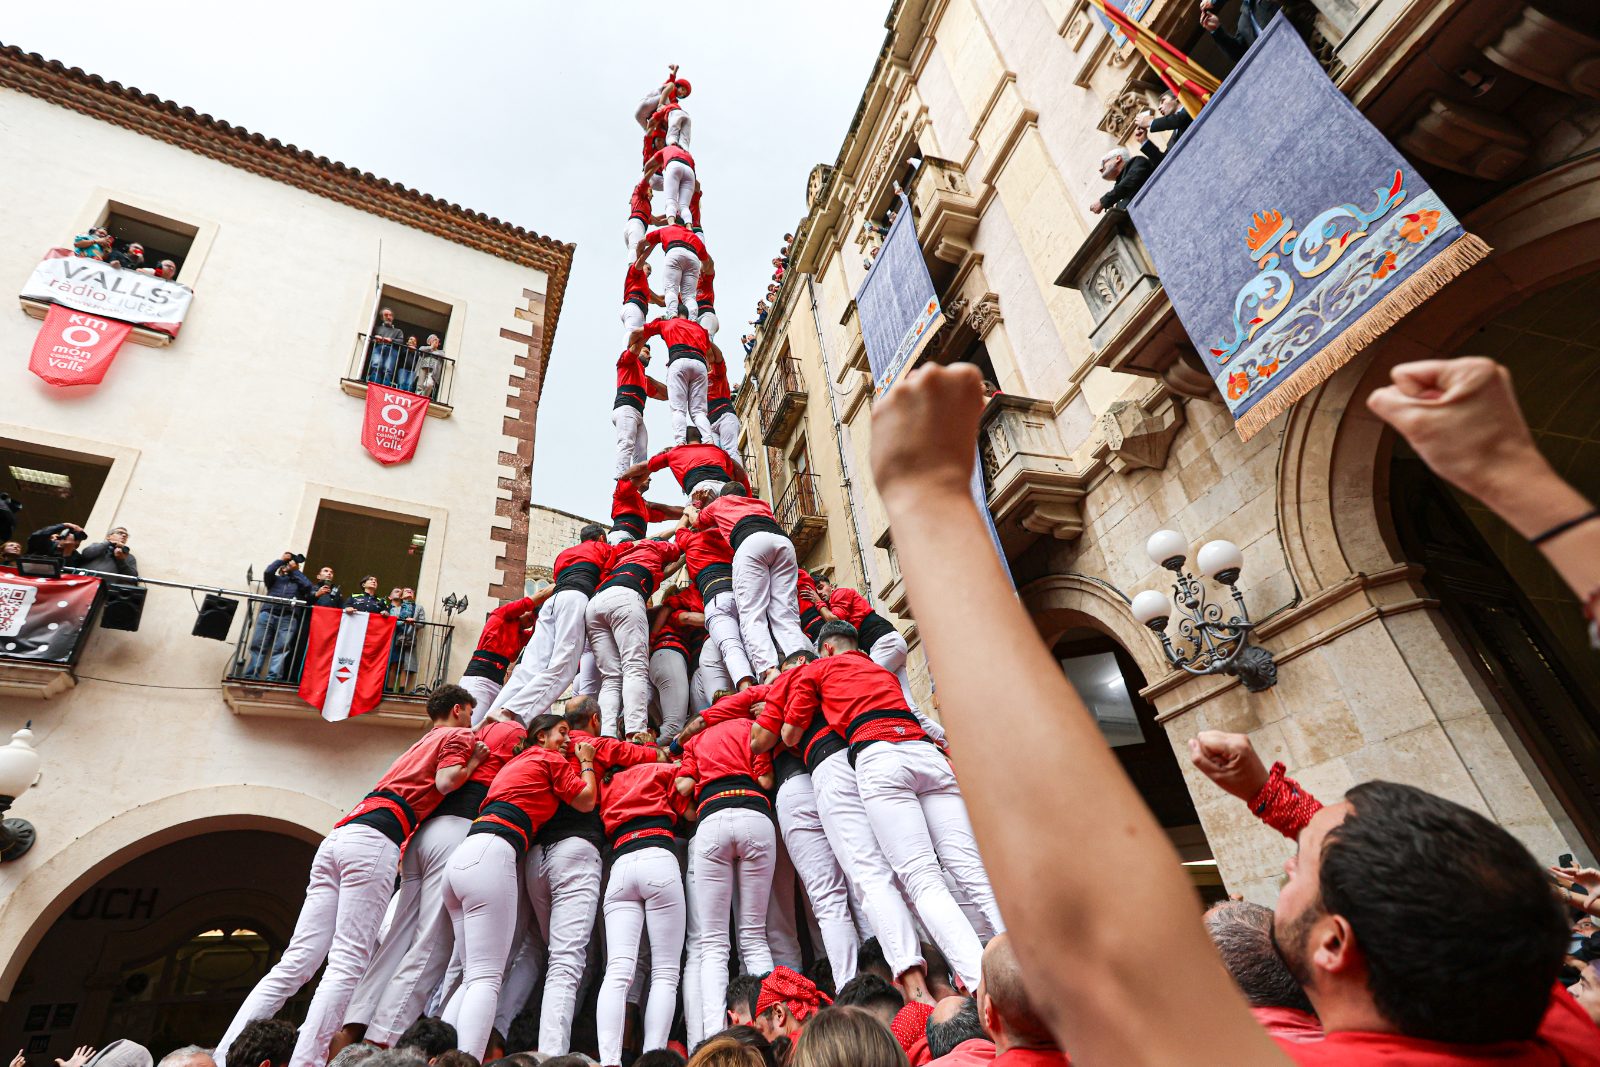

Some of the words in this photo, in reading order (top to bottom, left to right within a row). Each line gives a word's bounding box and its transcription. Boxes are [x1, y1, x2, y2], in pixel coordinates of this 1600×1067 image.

[63, 260, 172, 305] VALLS
[65, 313, 108, 331] km
[52, 345, 92, 360] món
[48, 357, 84, 372] Valls
[383, 392, 412, 408] km
[377, 424, 405, 437] món
[375, 437, 402, 451] Valls
